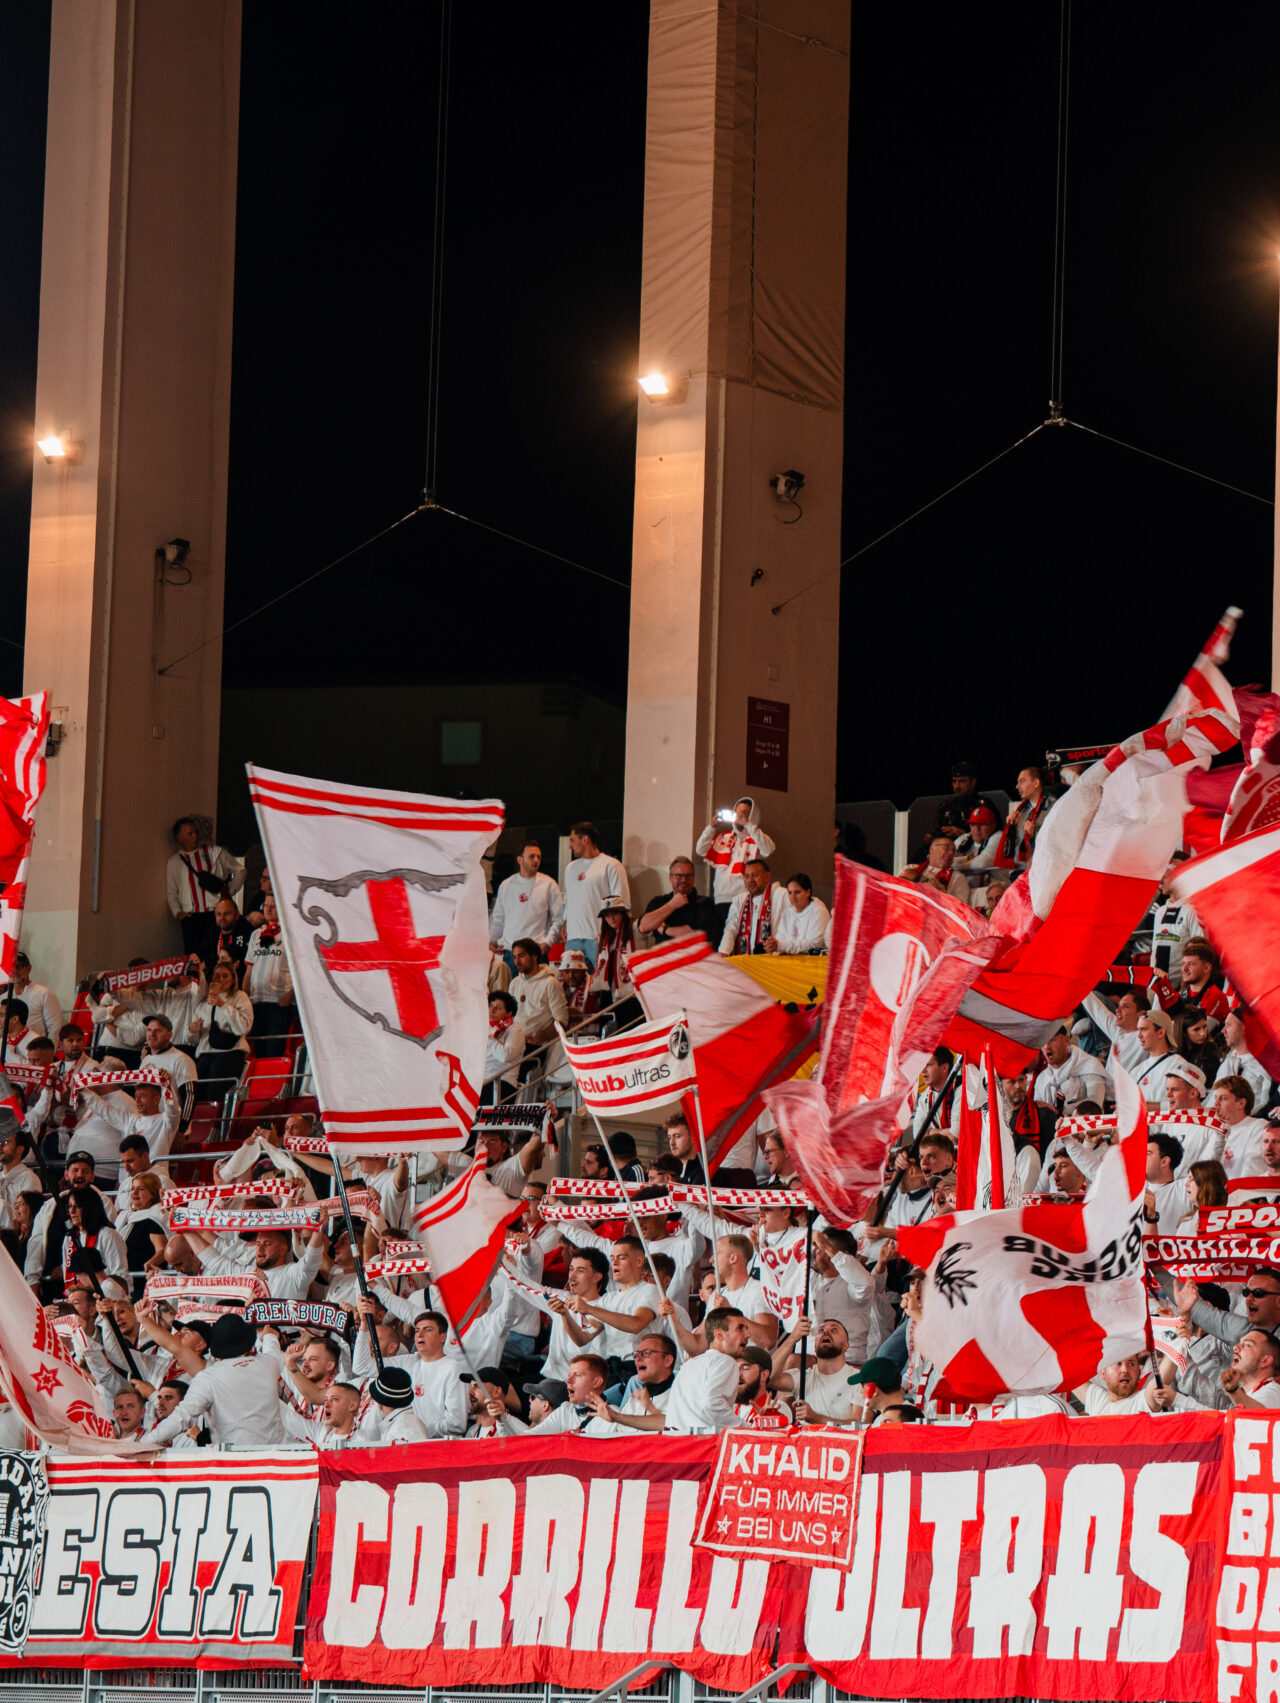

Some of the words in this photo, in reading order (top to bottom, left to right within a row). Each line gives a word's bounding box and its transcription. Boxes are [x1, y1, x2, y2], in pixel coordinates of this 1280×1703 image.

[108, 961, 186, 992] FREIBURG
[485, 1115, 505, 1126] PER
[492, 1104, 548, 1115] FREIBURG
[244, 1301, 348, 1332] FREIBURG
[728, 1442, 851, 1481] KHALID
[719, 1480, 772, 1509] FÜR
[776, 1488, 848, 1517] IMMER
[736, 1516, 773, 1540] BEI
[779, 1519, 828, 1546] UNS
[322, 1473, 769, 1656] CORRILLO
[804, 1460, 1200, 1664] ULTRAS
